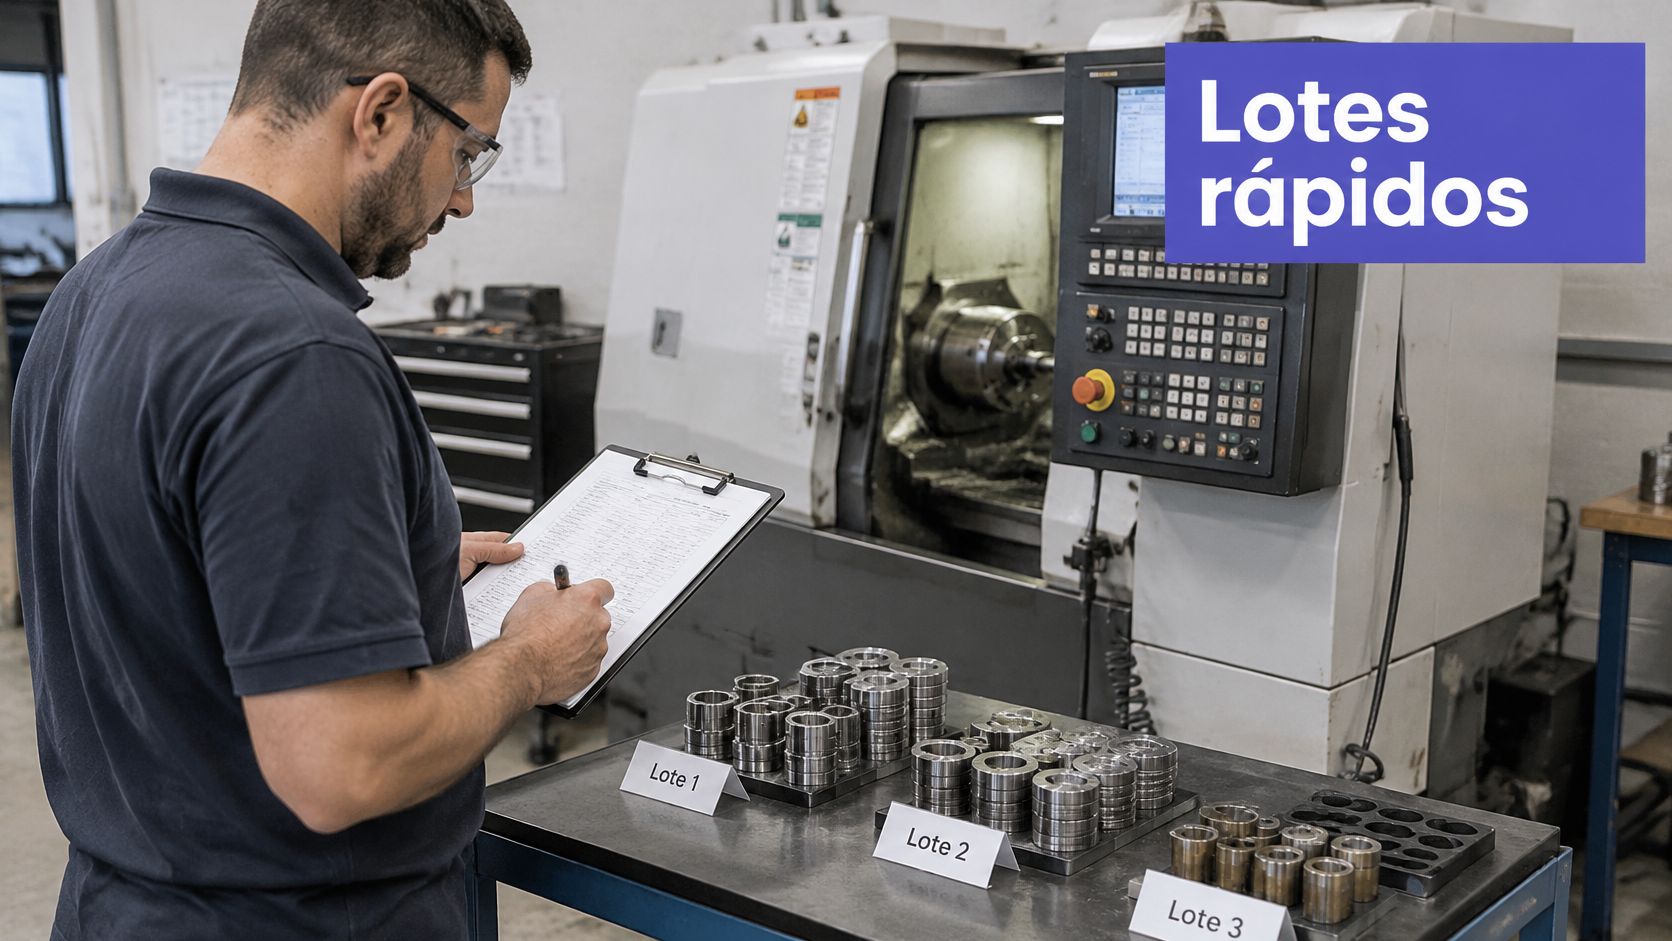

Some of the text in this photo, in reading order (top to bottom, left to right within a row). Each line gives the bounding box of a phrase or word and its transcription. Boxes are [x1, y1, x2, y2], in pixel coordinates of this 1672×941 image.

[649, 762, 700, 792] Lote 1
[906, 827, 970, 862] Lote 2
[1168, 899, 1244, 939] Lote 3
